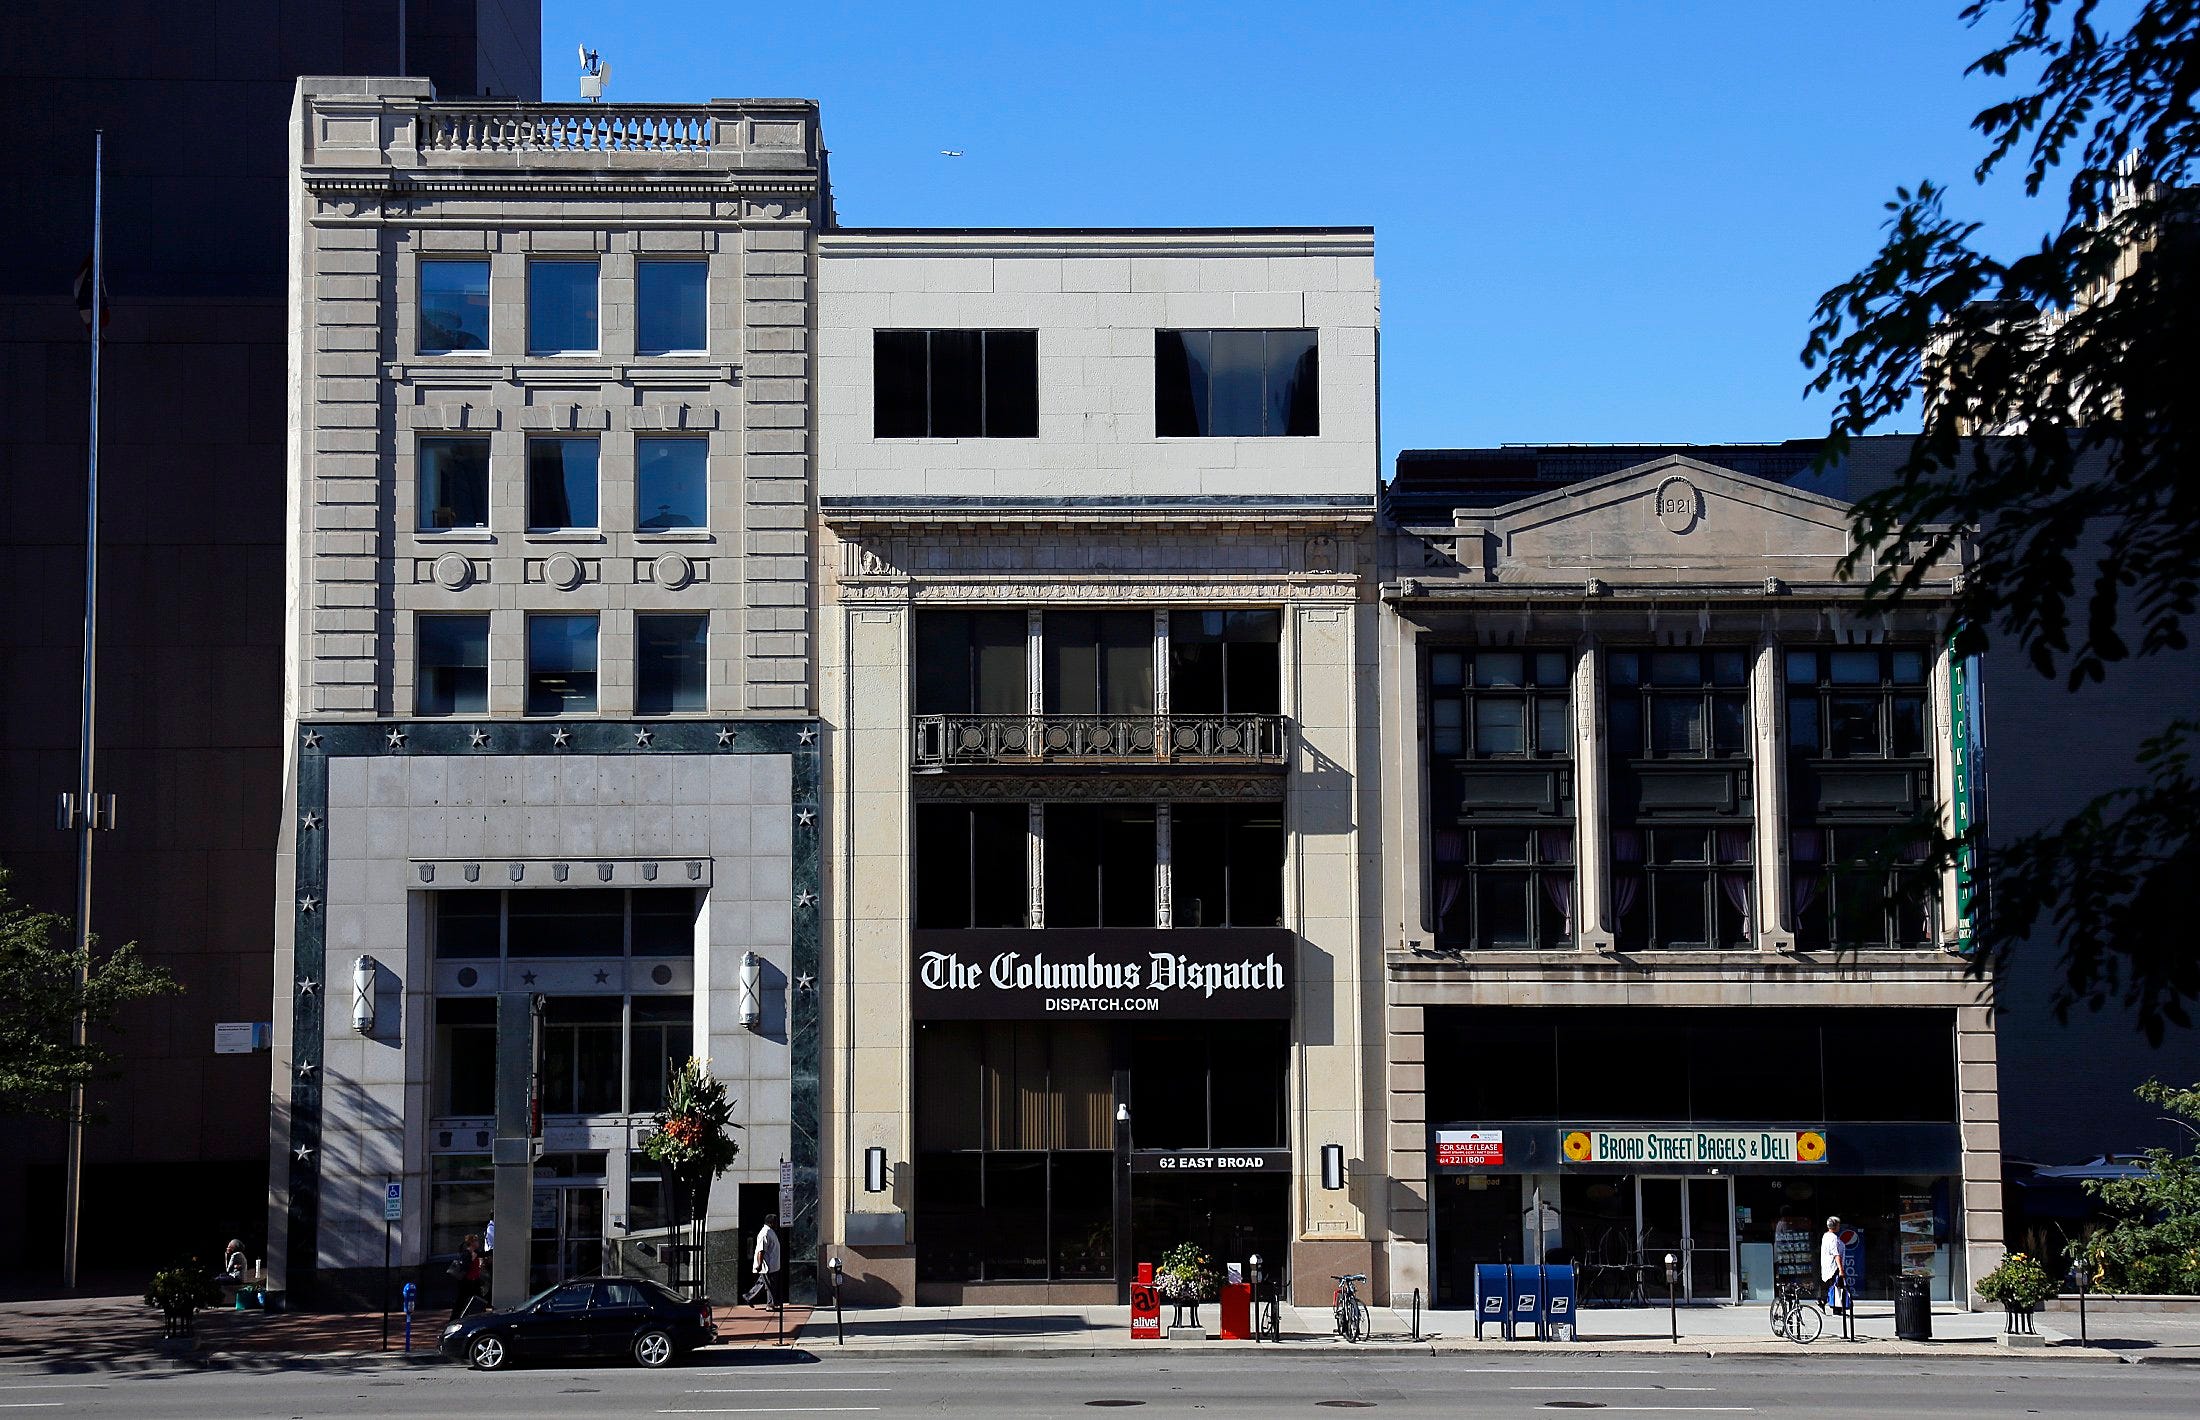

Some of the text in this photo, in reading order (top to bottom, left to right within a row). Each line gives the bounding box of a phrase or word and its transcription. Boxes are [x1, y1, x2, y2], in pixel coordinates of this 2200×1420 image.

[1662, 499, 1691, 513] 1921
[919, 950, 1285, 998] The Columbus Dispatch
[1045, 998, 1159, 1012] DISPATCH.COM
[1599, 1133, 1790, 1160] BROAD STREET BAGELS & DELI
[1160, 1157, 1264, 1169] 62 EAST BROAD
[1771, 1180, 1783, 1189] 66
[1133, 1316, 1158, 1327] alive!
